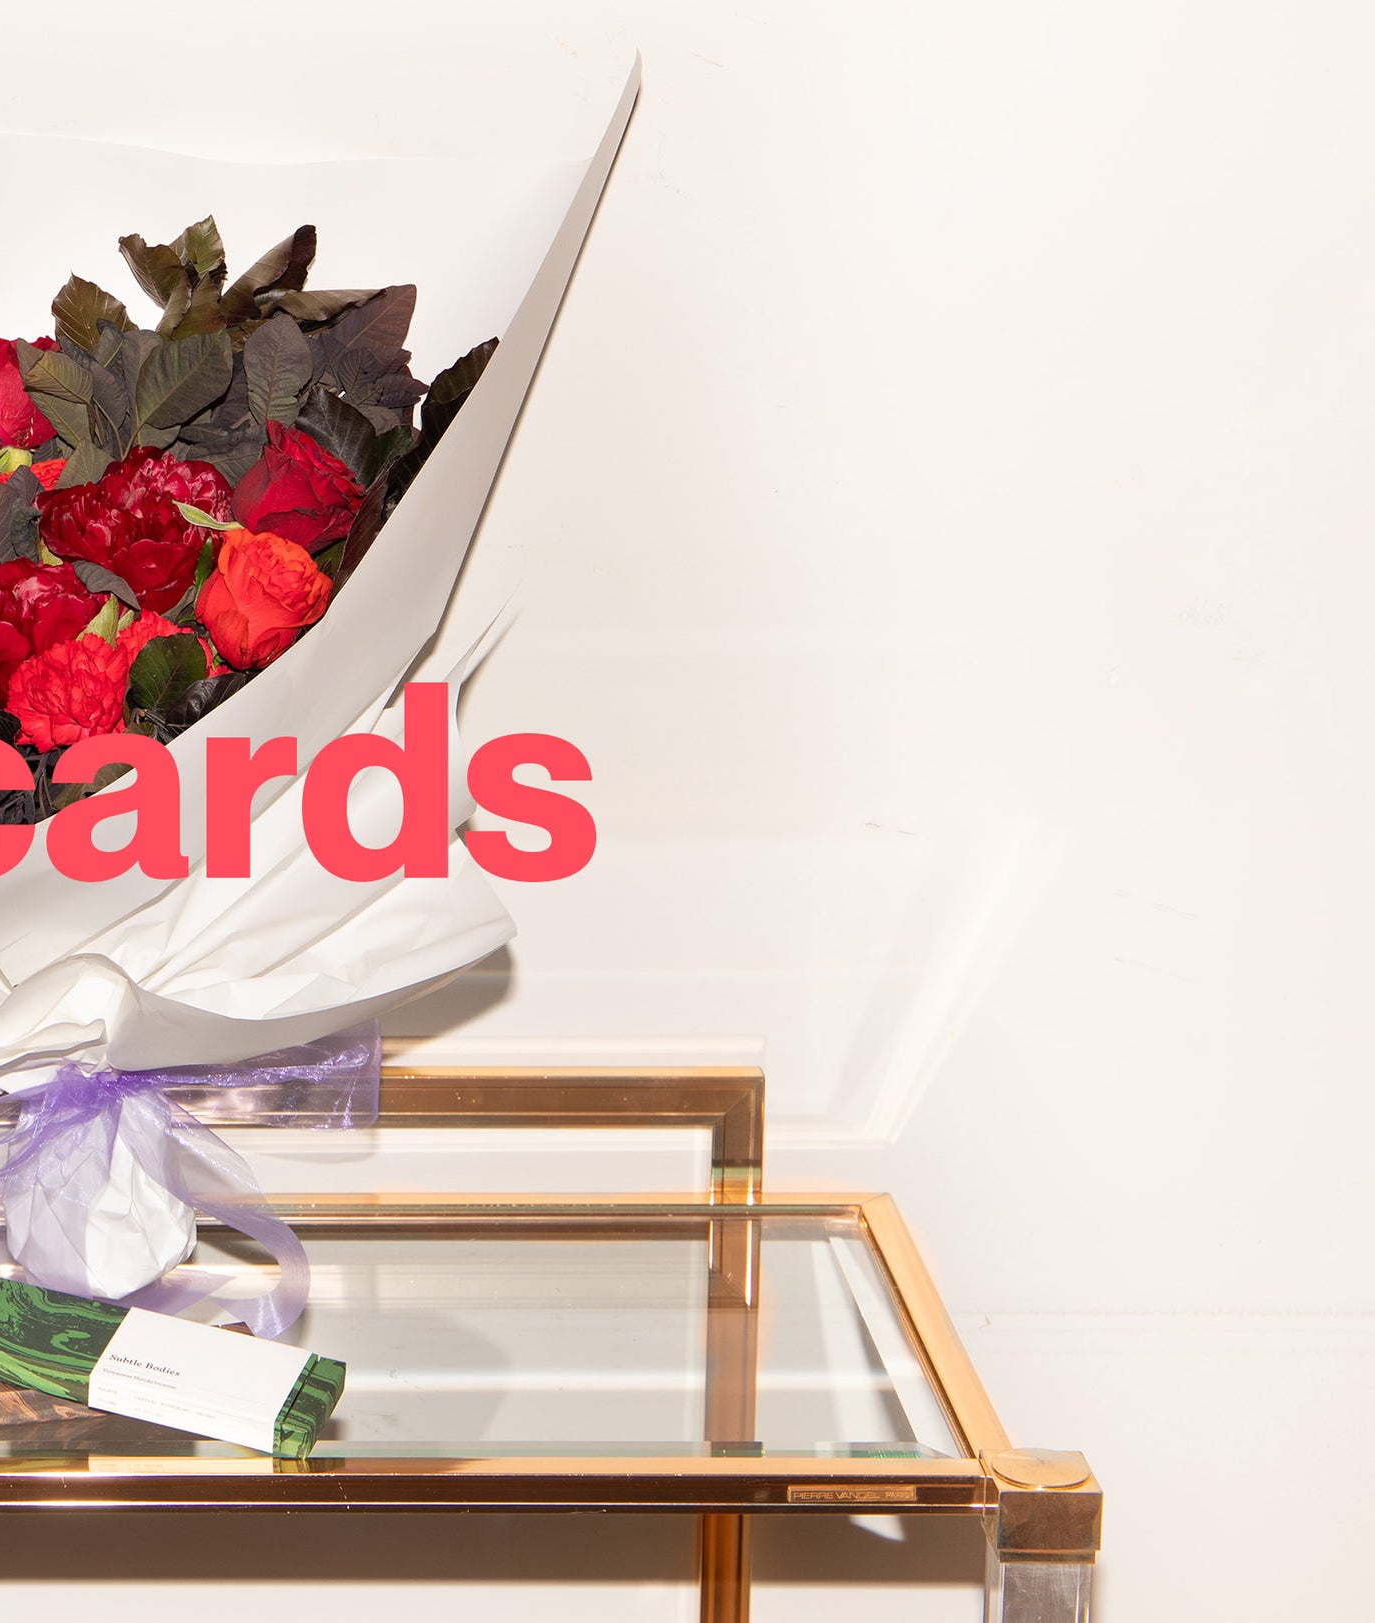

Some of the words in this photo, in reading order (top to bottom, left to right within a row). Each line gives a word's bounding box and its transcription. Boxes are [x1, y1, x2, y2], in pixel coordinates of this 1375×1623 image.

[109, 1354, 143, 1368] Subtle
[145, 1362, 181, 1377] Bodies
[793, 1491, 834, 1500] PIERRE
